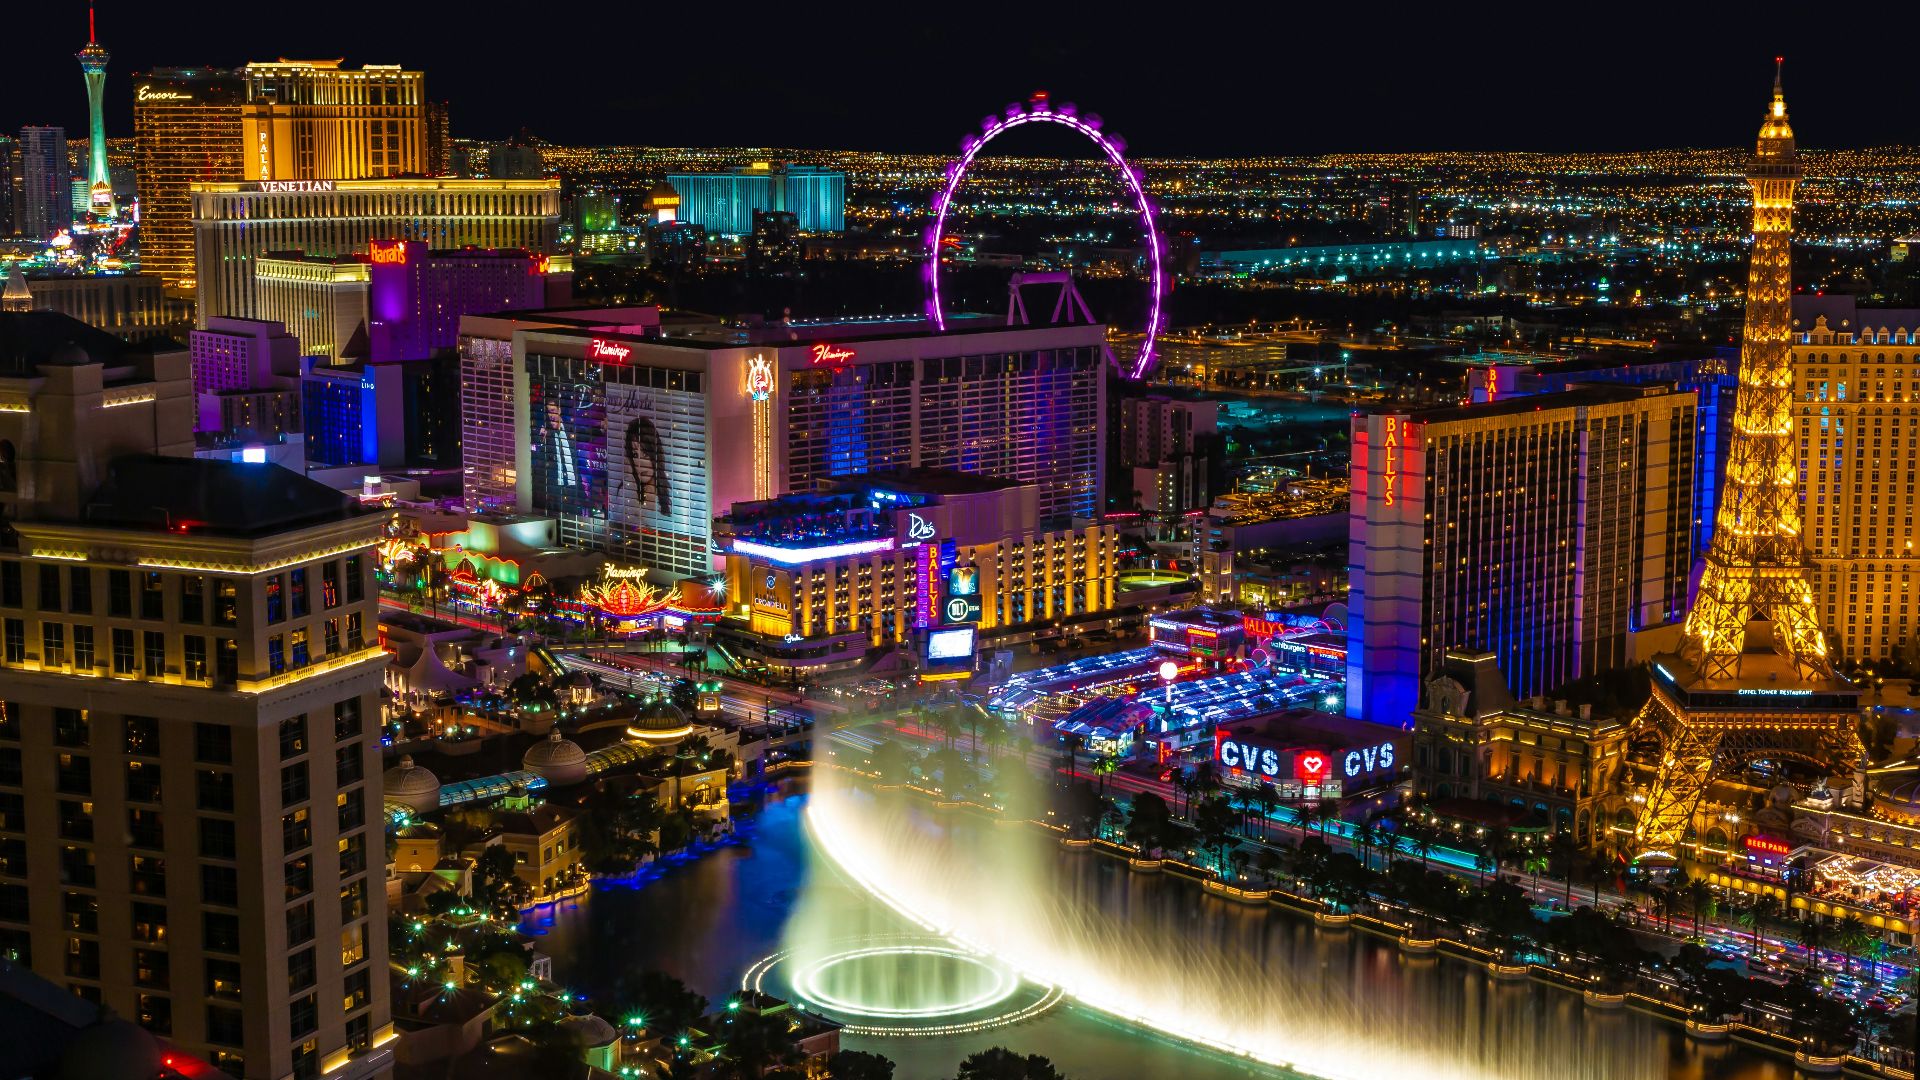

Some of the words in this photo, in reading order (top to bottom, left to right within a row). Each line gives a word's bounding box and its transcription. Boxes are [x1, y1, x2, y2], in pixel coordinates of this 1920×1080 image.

[138, 85, 192, 101] Encore
[260, 180, 333, 193] VENETIAN
[593, 339, 631, 362] Flamingo
[812, 344, 855, 363] Flamingo
[1384, 417, 1398, 506] BALLYS
[604, 562, 649, 583] Flamingo
[928, 547, 939, 618] BALLYS
[1244, 616, 1284, 635] BALLY'S
[1221, 741, 1279, 776] CVS
[1345, 742, 1394, 777] CVS
[1747, 838, 1766, 850] BEER
[1768, 843, 1788, 854] PARK
